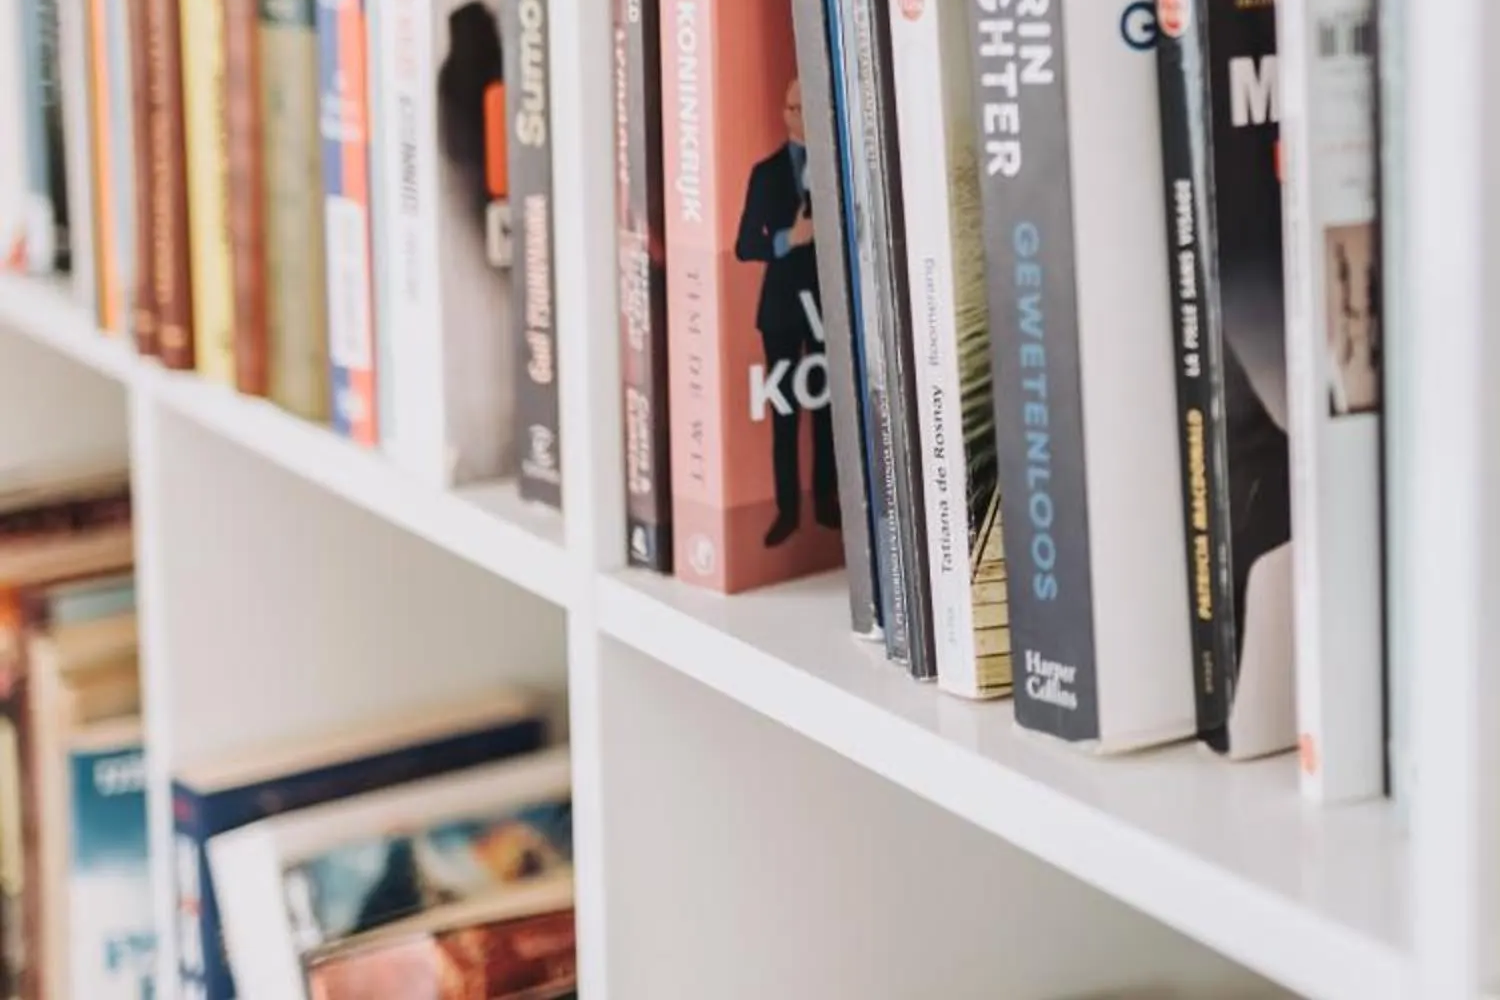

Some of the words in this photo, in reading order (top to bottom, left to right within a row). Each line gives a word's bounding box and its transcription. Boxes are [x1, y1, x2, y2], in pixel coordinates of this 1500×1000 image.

[676, 1, 702, 225] KONINKRIJK
[922, 257, 940, 366] Boomerang
[1179, 251, 1198, 300] SANS
[1180, 305, 1201, 349] FILLE
[1183, 355, 1201, 378] LA
[929, 384, 947, 459] Rosnay
[1013, 220, 1058, 601] GEWETENLOOS
[934, 466, 948, 493] de
[1186, 408, 1208, 531] MACDONALD
[937, 498, 953, 574] Tatiana
